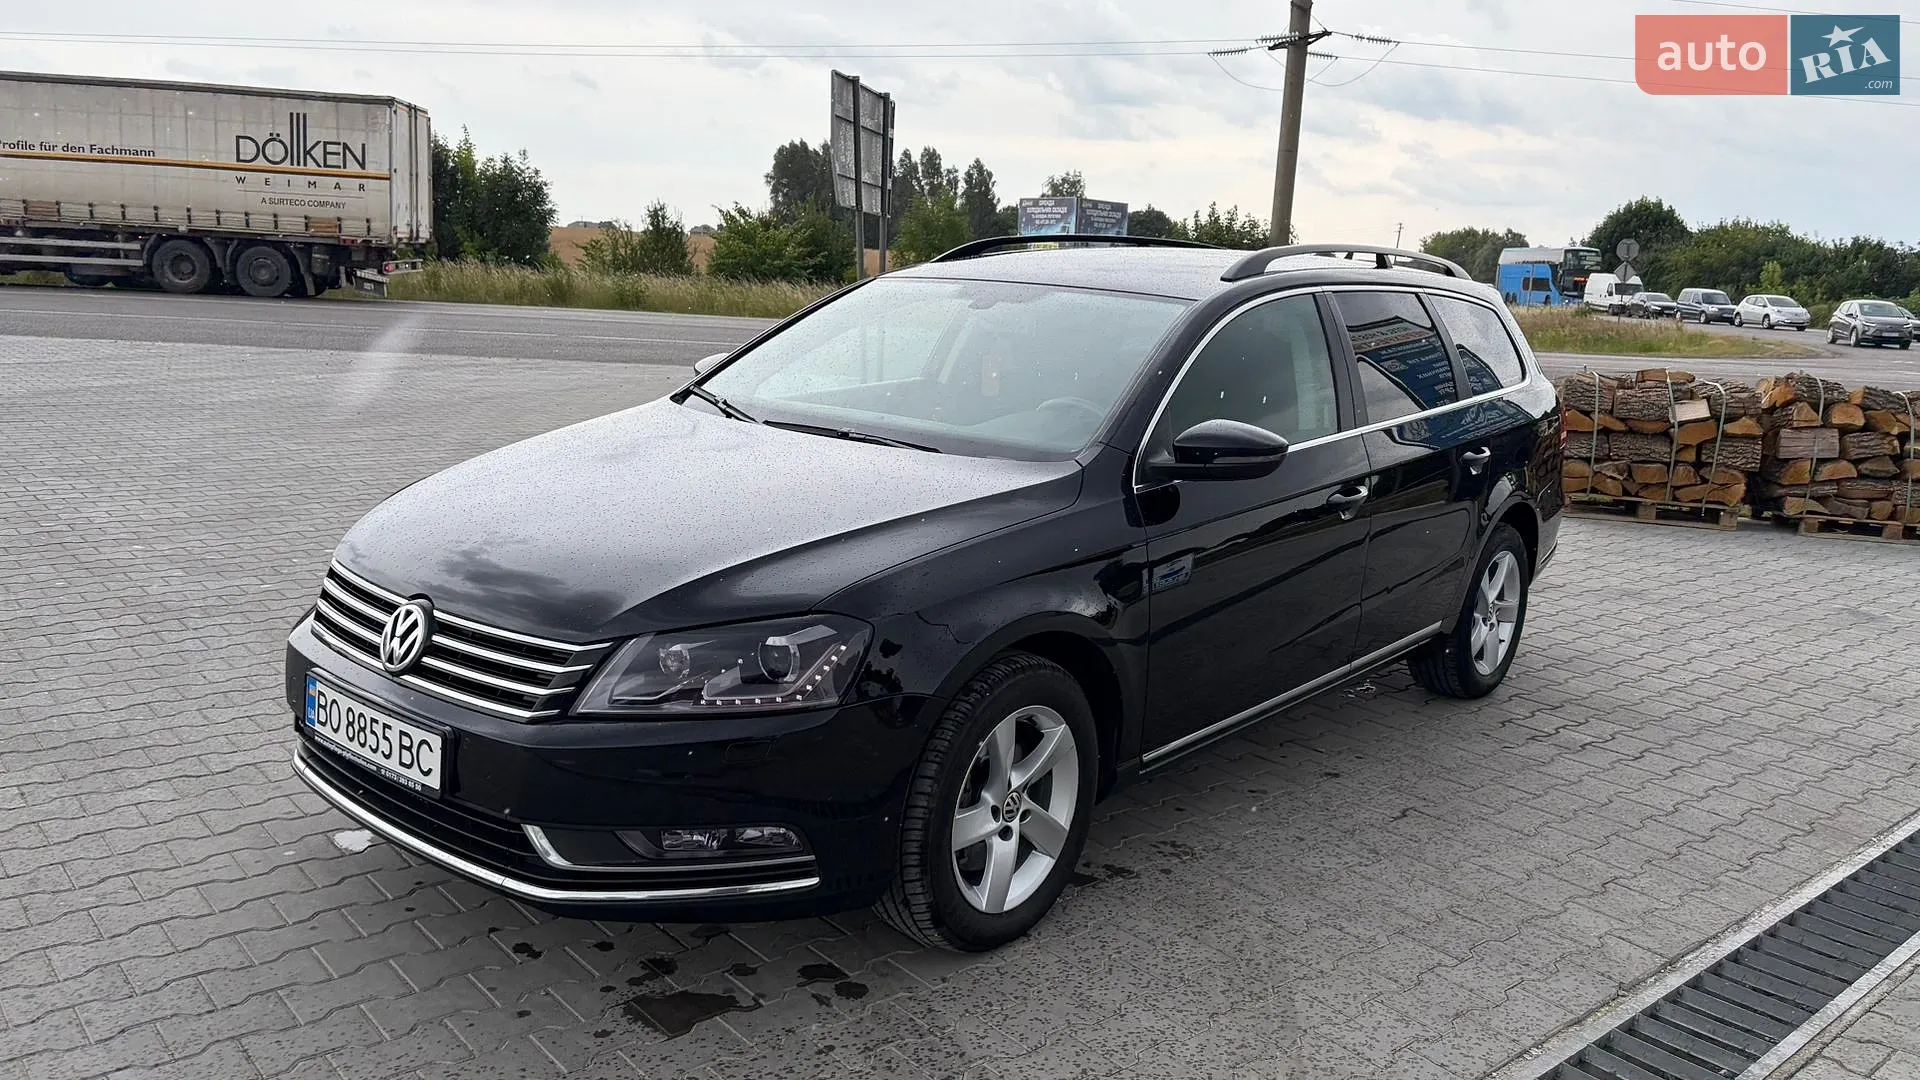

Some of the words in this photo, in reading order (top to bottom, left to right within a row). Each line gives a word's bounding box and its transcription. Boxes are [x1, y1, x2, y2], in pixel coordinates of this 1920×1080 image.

[0, 139, 36, 151] rofile
[39, 141, 58, 152] für
[61, 142, 86, 153] den
[90, 144, 156, 157] Fachmann
[235, 175, 367, 192] WEIMAR
[260, 197, 267, 205] A
[268, 198, 306, 207] SURTECO
[307, 199, 346, 209] COMPANY
[317, 689, 342, 734] BO
[345, 706, 393, 760] 8855
[398, 729, 435, 777] BC
